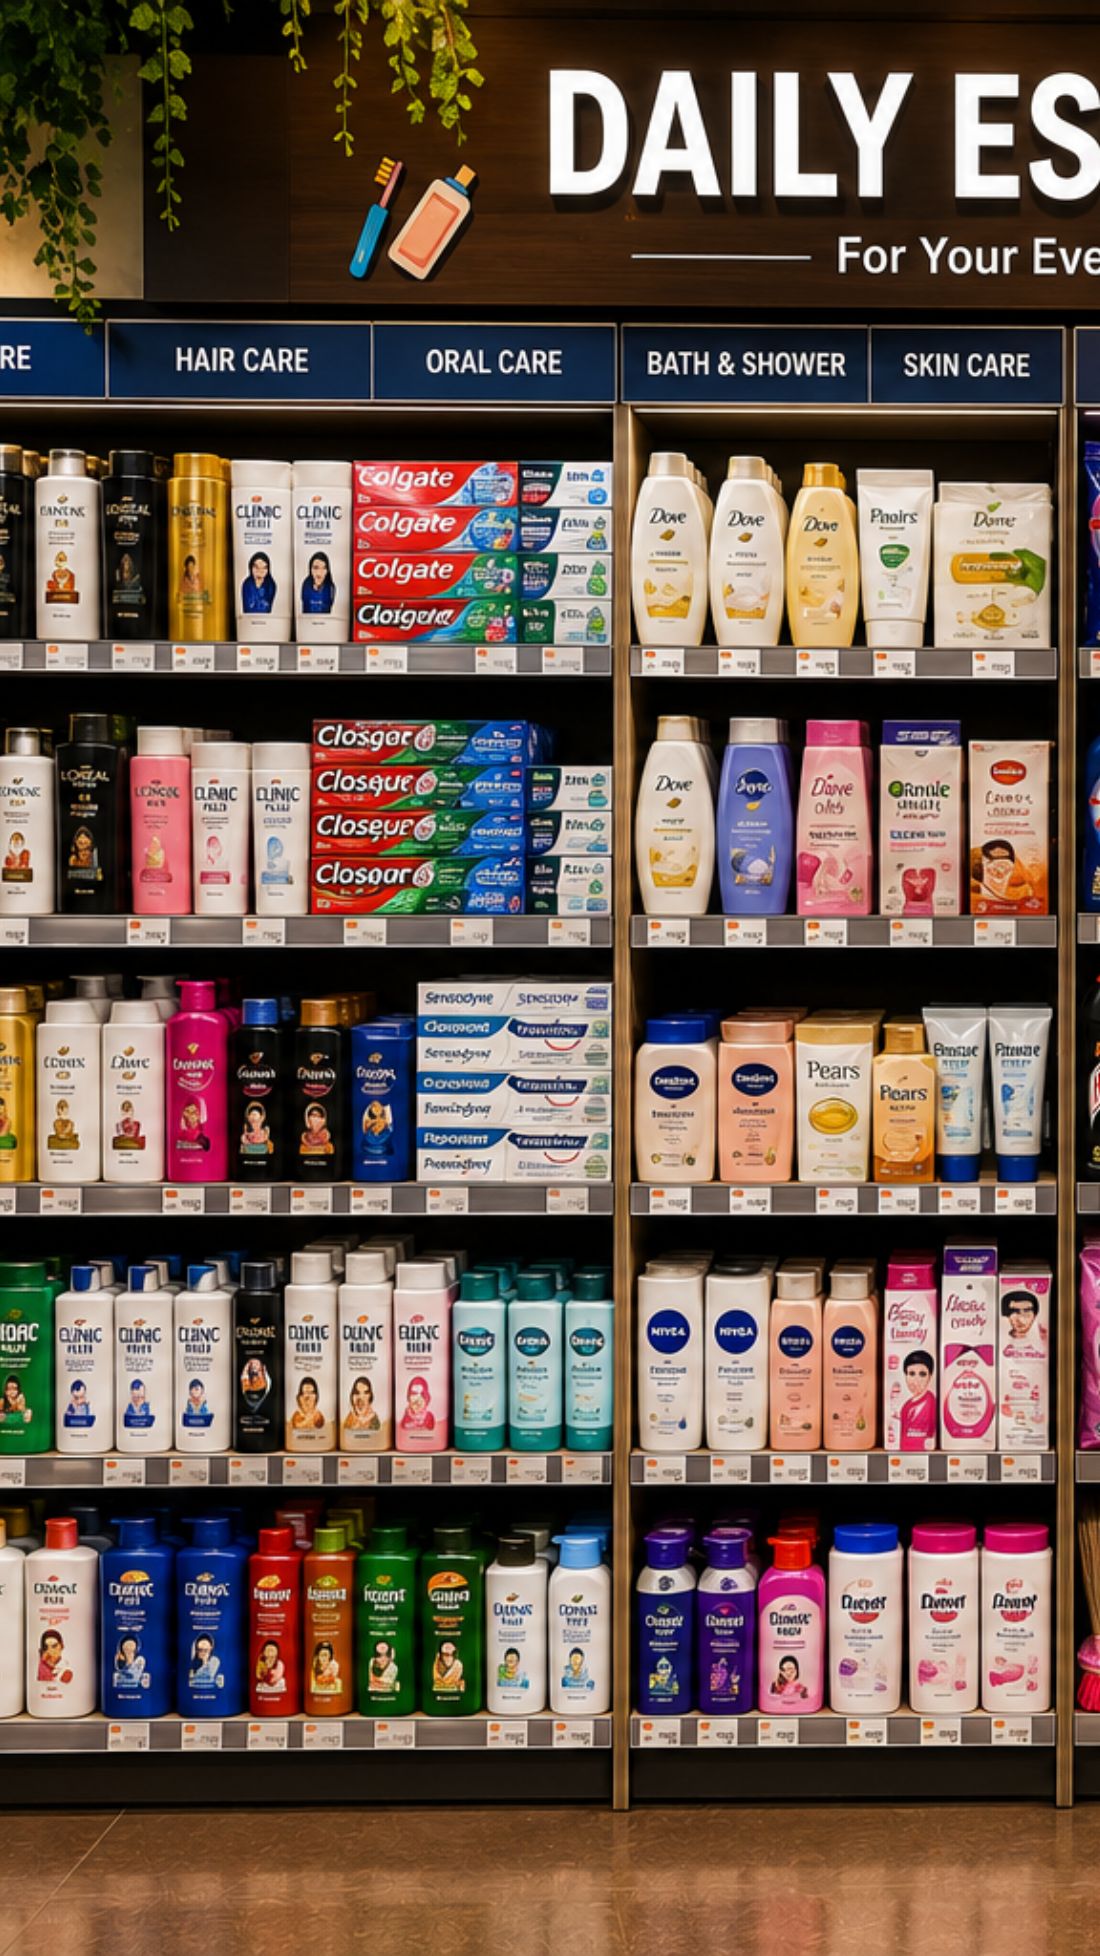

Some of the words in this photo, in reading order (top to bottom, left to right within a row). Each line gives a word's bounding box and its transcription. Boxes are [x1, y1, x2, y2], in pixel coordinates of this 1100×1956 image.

[549, 70, 913, 198] DAILY
[954, 72, 1100, 201] ES
[837, 236, 906, 275] For
[919, 236, 1018, 275] Your
[1033, 238, 1100, 275] Eve
[175, 347, 235, 372] HAIR
[243, 347, 309, 373] CARE
[426, 349, 491, 374] ORAL
[498, 349, 562, 374] CARE
[647, 351, 709, 375] BATH
[718, 352, 735, 375] &
[742, 351, 846, 376] SHOWER
[904, 353, 959, 376] SKIN
[967, 353, 1030, 377] CARE
[358, 464, 455, 491] Colgate
[235, 504, 282, 519] CLINIC
[296, 505, 343, 520] CLINIC
[649, 507, 687, 524] Dove
[727, 509, 765, 527] Dove
[358, 511, 456, 538] Colgate
[357, 557, 454, 584] Colgate
[655, 774, 693, 792] Dove
[424, 991, 494, 1006] Sensodyne
[807, 1061, 860, 1080] Pears
